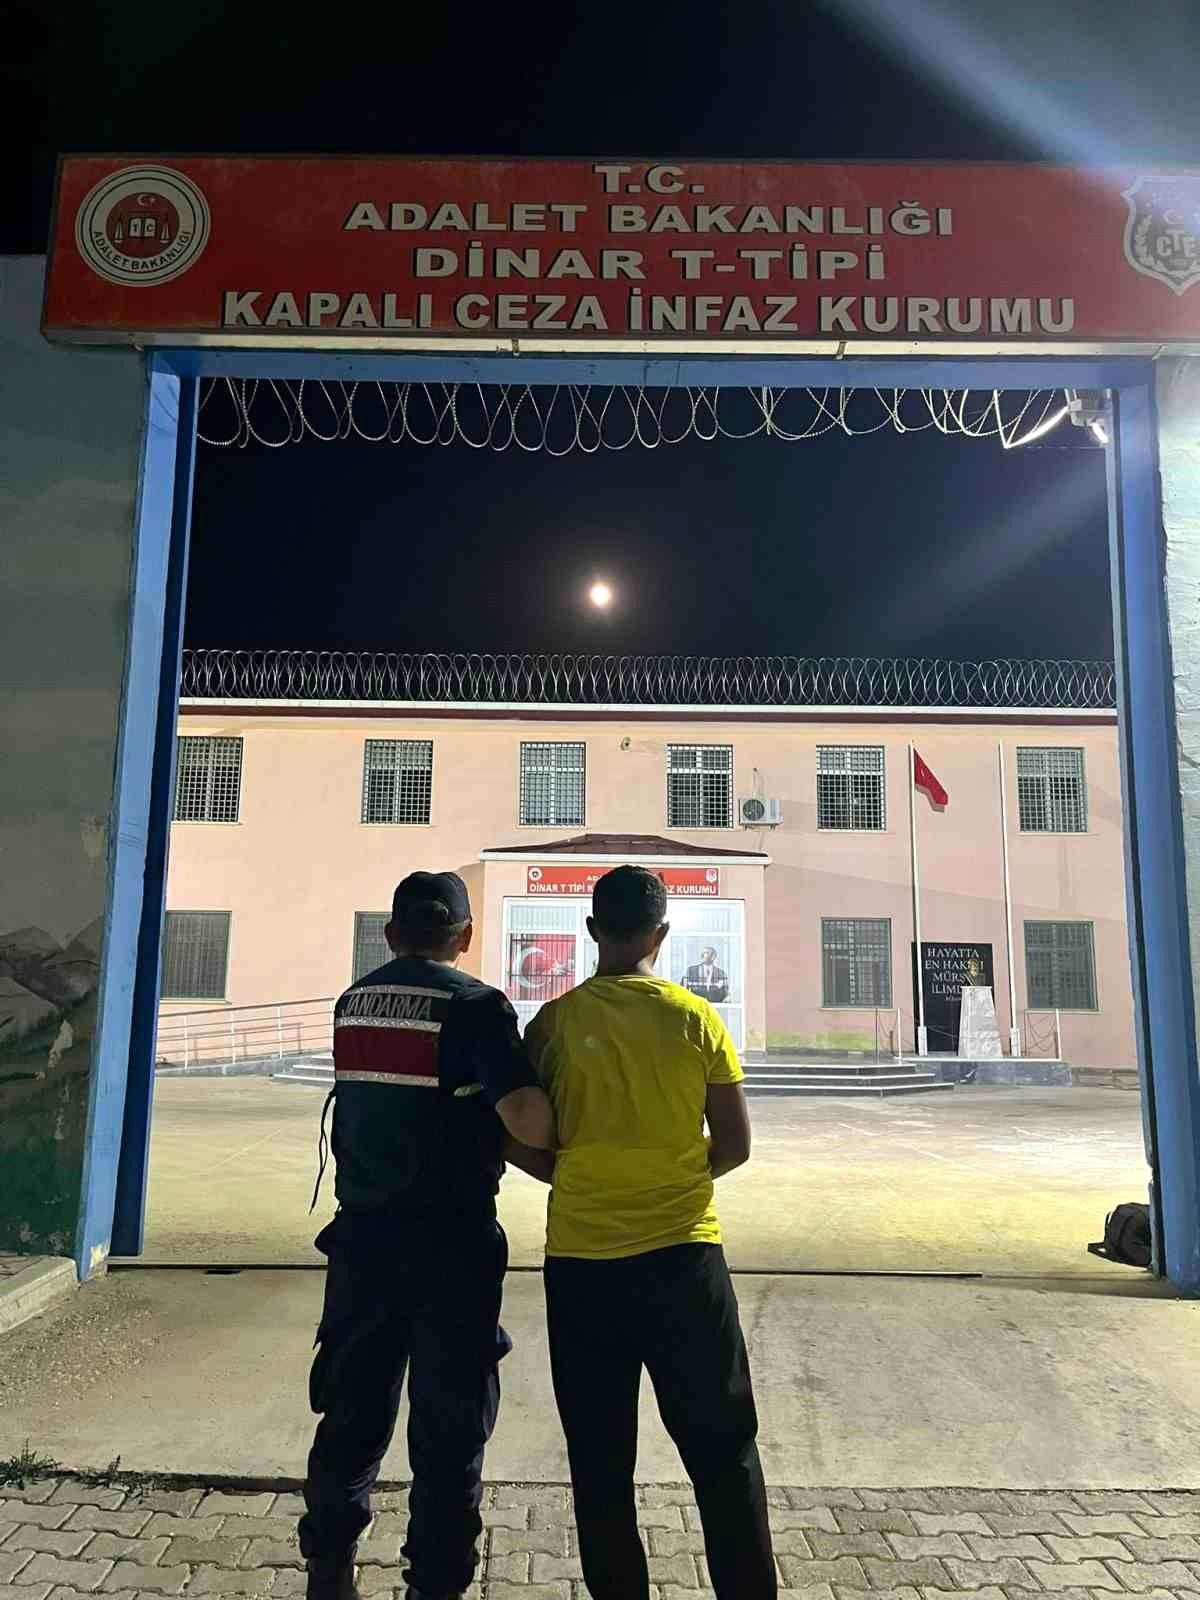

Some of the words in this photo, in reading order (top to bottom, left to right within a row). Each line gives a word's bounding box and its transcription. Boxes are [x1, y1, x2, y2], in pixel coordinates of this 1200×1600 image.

[594, 165, 705, 194] T.C.
[344, 203, 588, 232] ADALET
[608, 200, 953, 235] BAKANLIĞI
[94, 231, 130, 267] ADALET
[414, 240, 646, 279] DİNAR
[672, 243, 885, 280] T-TİPİ
[222, 291, 432, 328] KAPALI
[454, 294, 608, 330] CEZA
[629, 287, 799, 332] İNFAZ
[820, 296, 1075, 333] KURUMU
[529, 881, 558, 893] DİNAR
[567, 881, 585, 893] TİPİ
[677, 884, 717, 894] KURUMU
[925, 960, 940, 969] EN
[927, 948, 979, 957] HAYATTA
[342, 992, 432, 1019] JANDARMA
